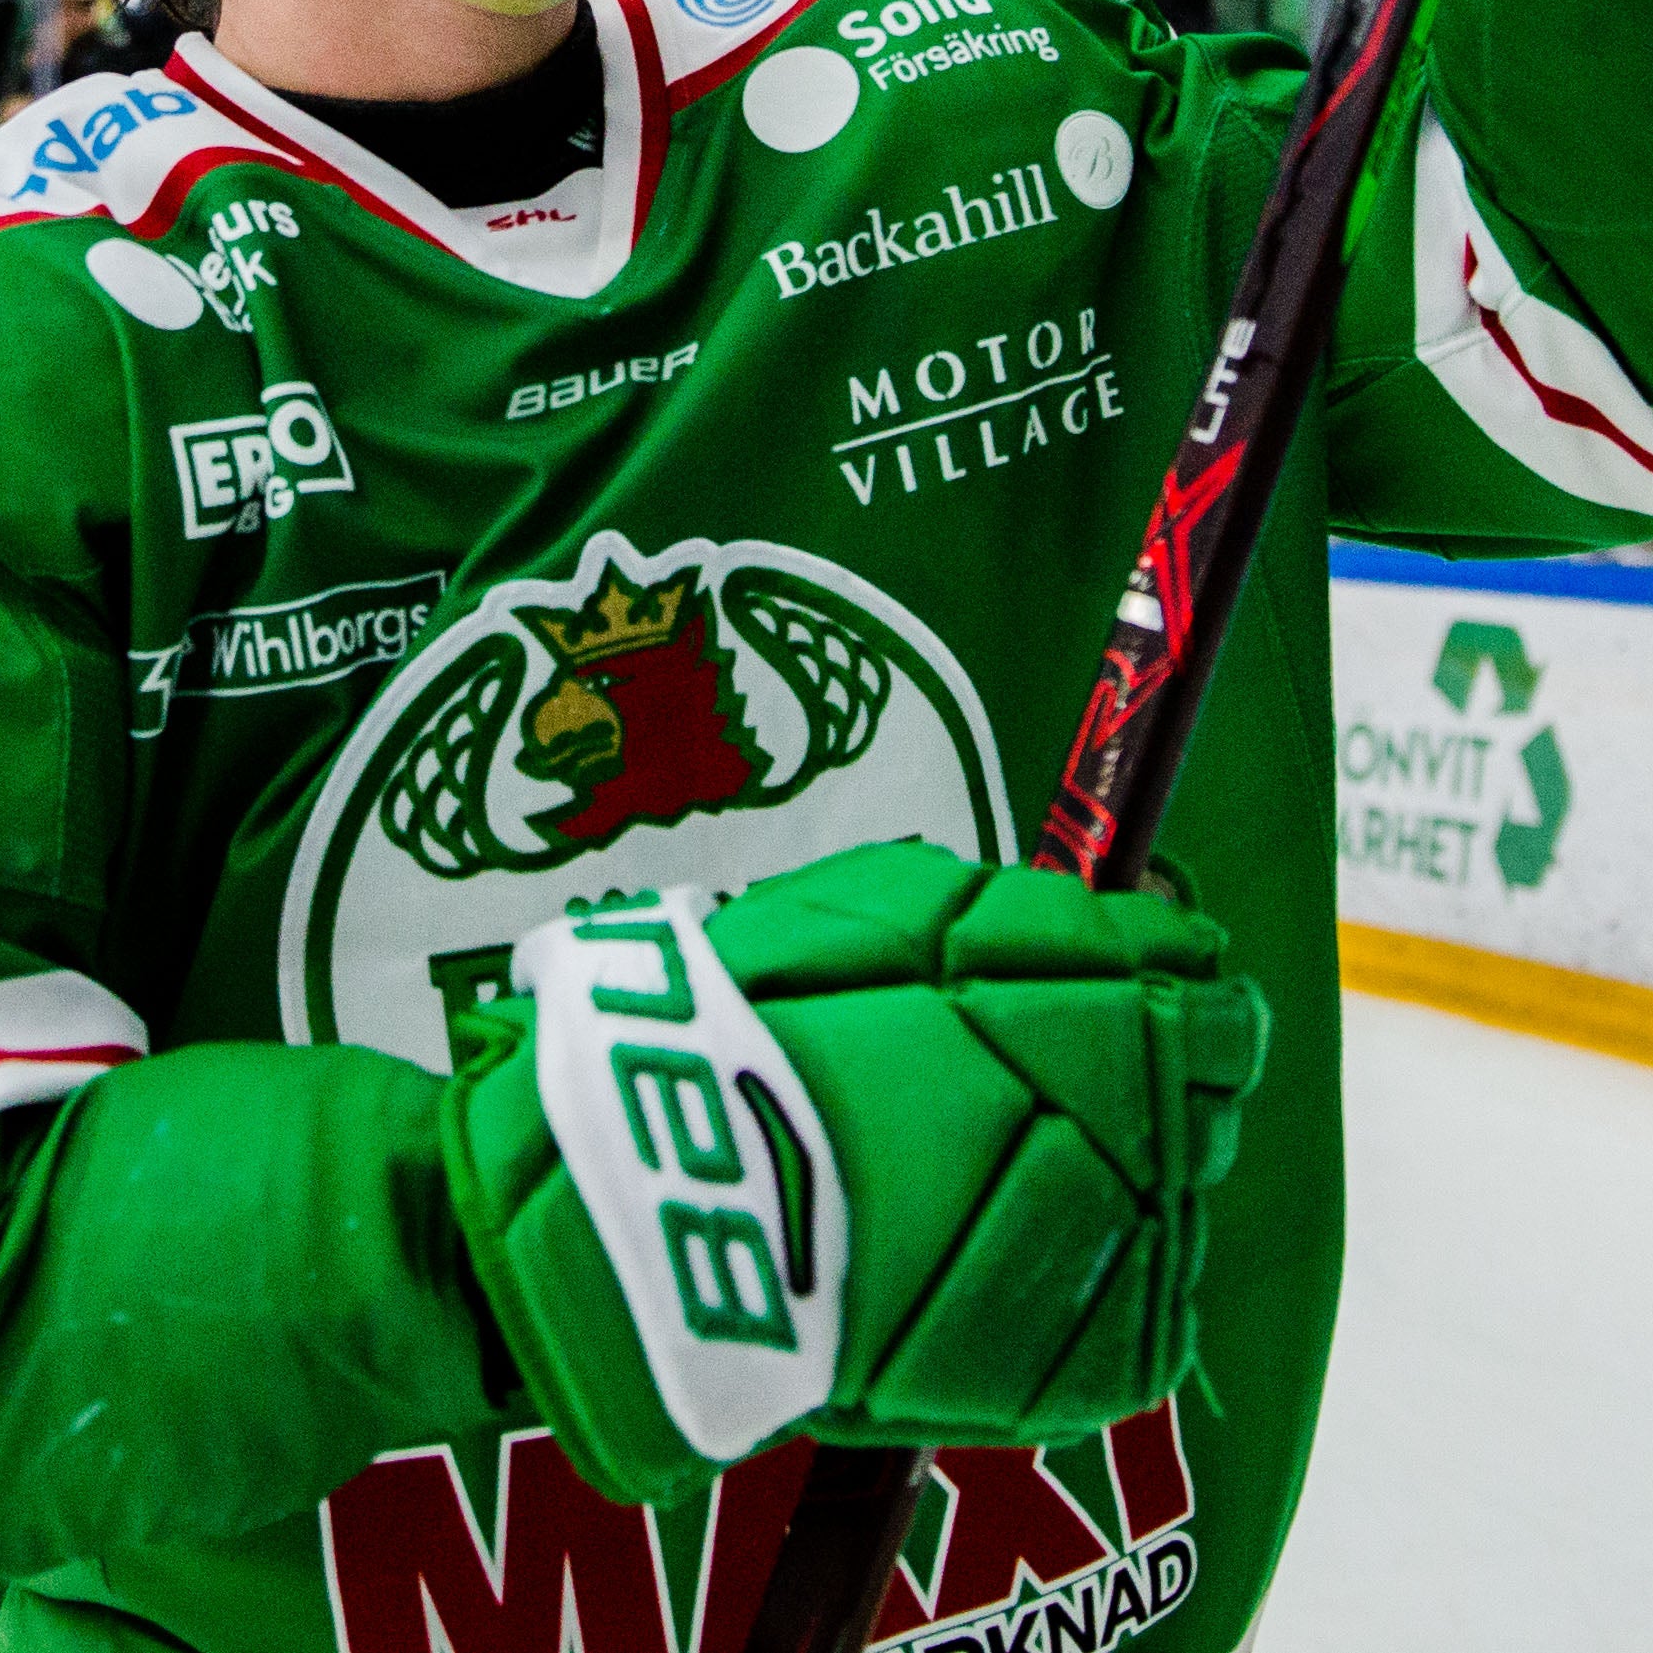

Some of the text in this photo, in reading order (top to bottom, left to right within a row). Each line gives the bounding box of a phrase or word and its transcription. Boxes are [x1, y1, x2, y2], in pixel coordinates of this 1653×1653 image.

[867, 17, 1059, 93] Försäkring
[761, 163, 1058, 299] Backahill
[848, 308, 1096, 424] MOTOR
[839, 370, 1125, 506] VILLAGE
